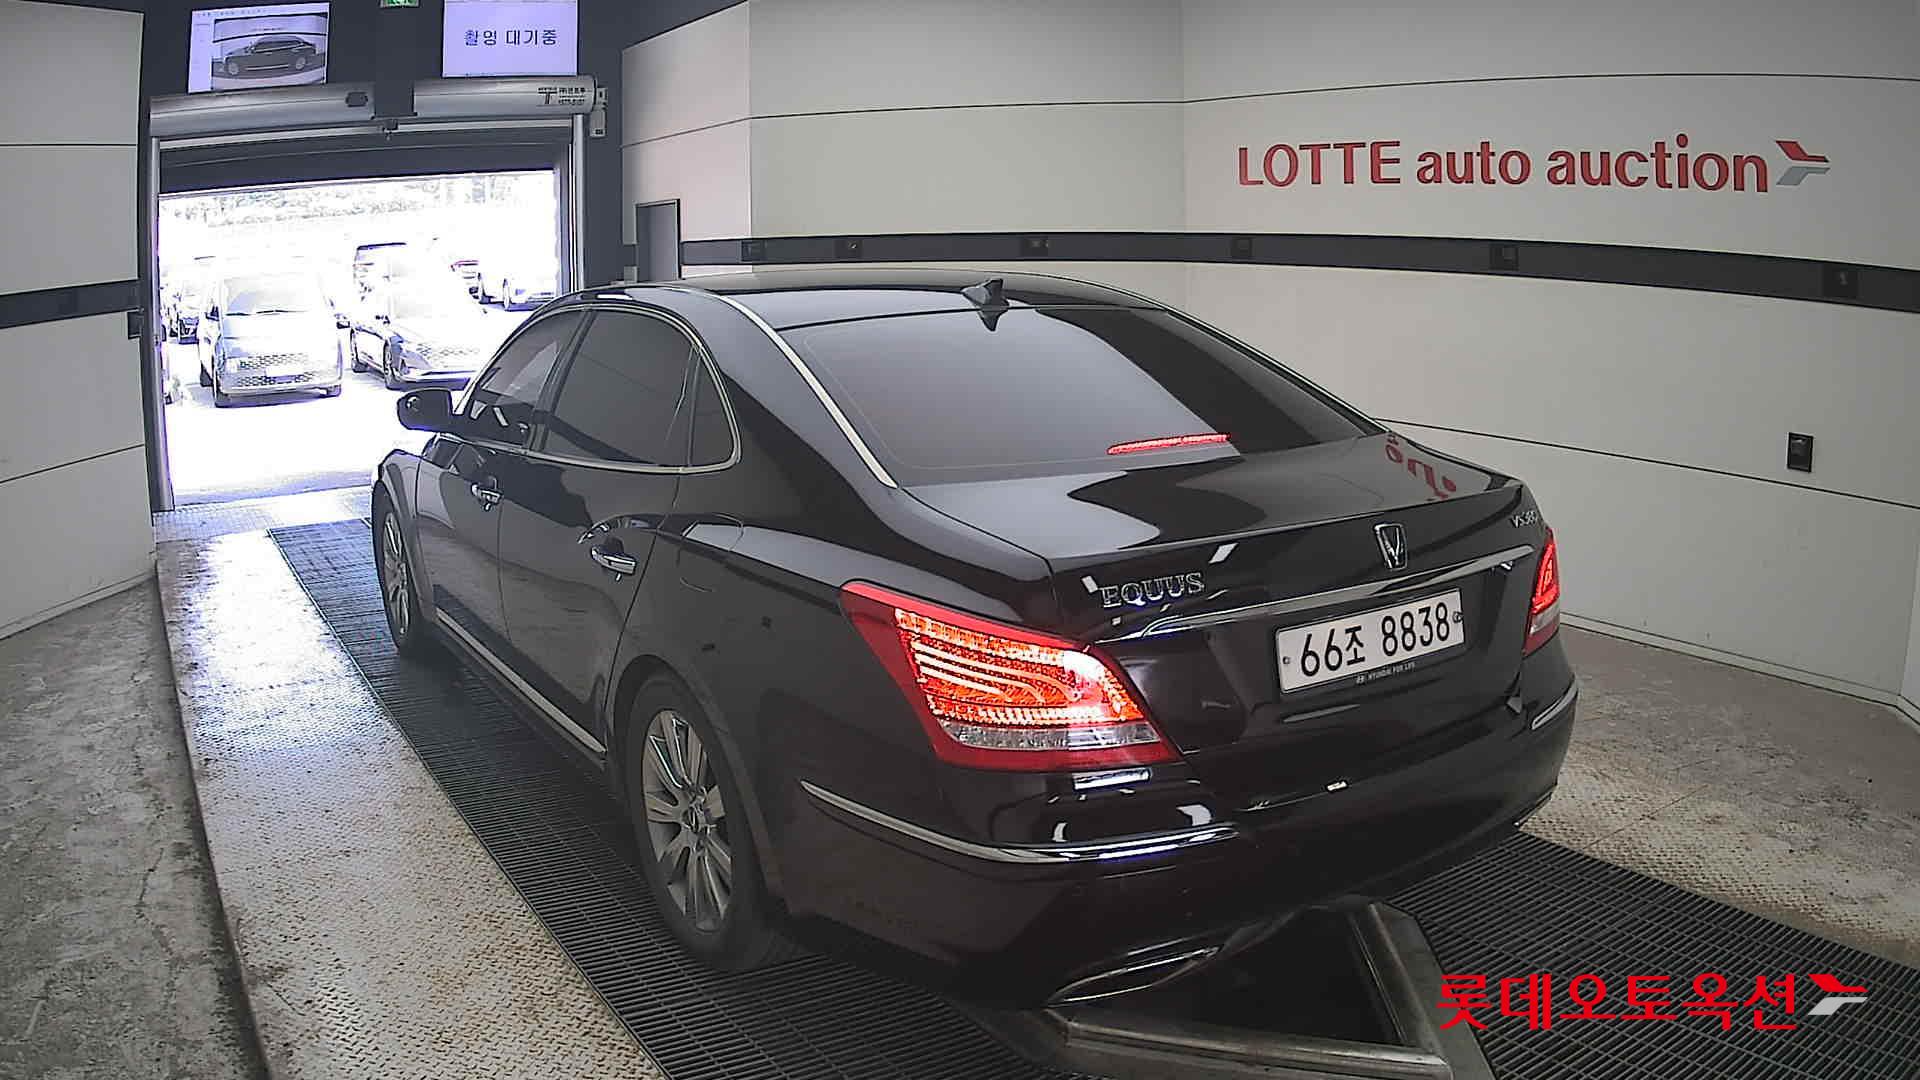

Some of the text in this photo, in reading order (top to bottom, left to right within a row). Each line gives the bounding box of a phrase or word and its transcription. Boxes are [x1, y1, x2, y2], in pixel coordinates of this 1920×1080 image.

[505, 29, 558, 46] 대기중
[1238, 133, 1769, 193] LOTTE auto auction
[1100, 572, 1205, 608] EQUUS
[1300, 602, 1450, 677] 66조 8838
